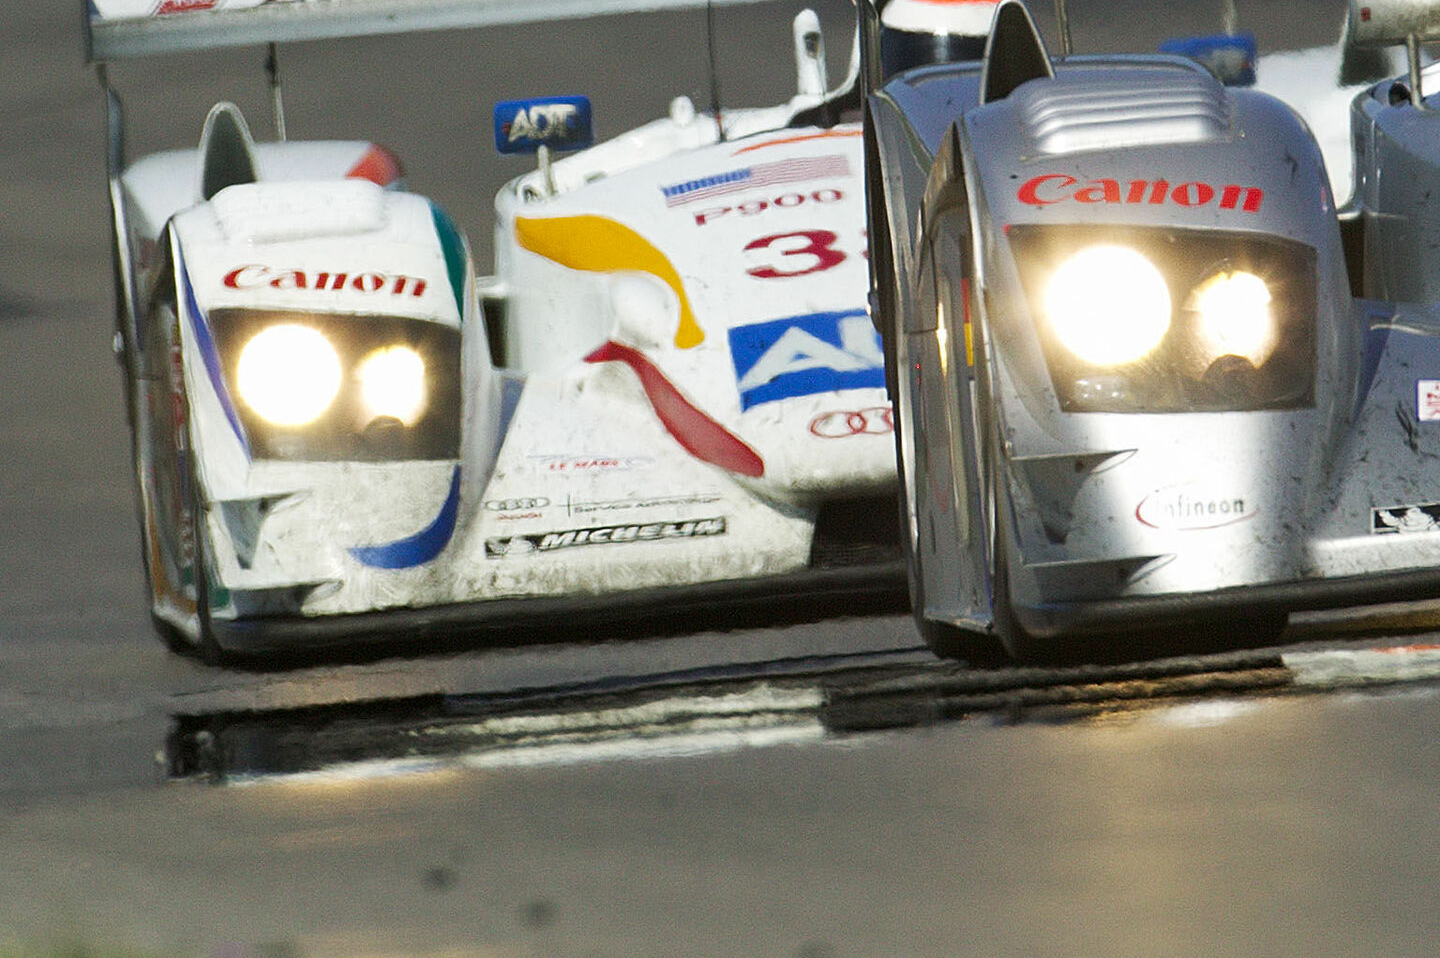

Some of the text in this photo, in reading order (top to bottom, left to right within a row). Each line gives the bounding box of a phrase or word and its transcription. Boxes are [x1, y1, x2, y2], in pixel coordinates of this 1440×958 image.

[508, 104, 576, 142] ADT
[693, 188, 844, 226] P900
[1017, 174, 1264, 213] Canon
[222, 264, 428, 298] Canon
[539, 517, 725, 550] MICHELIN
